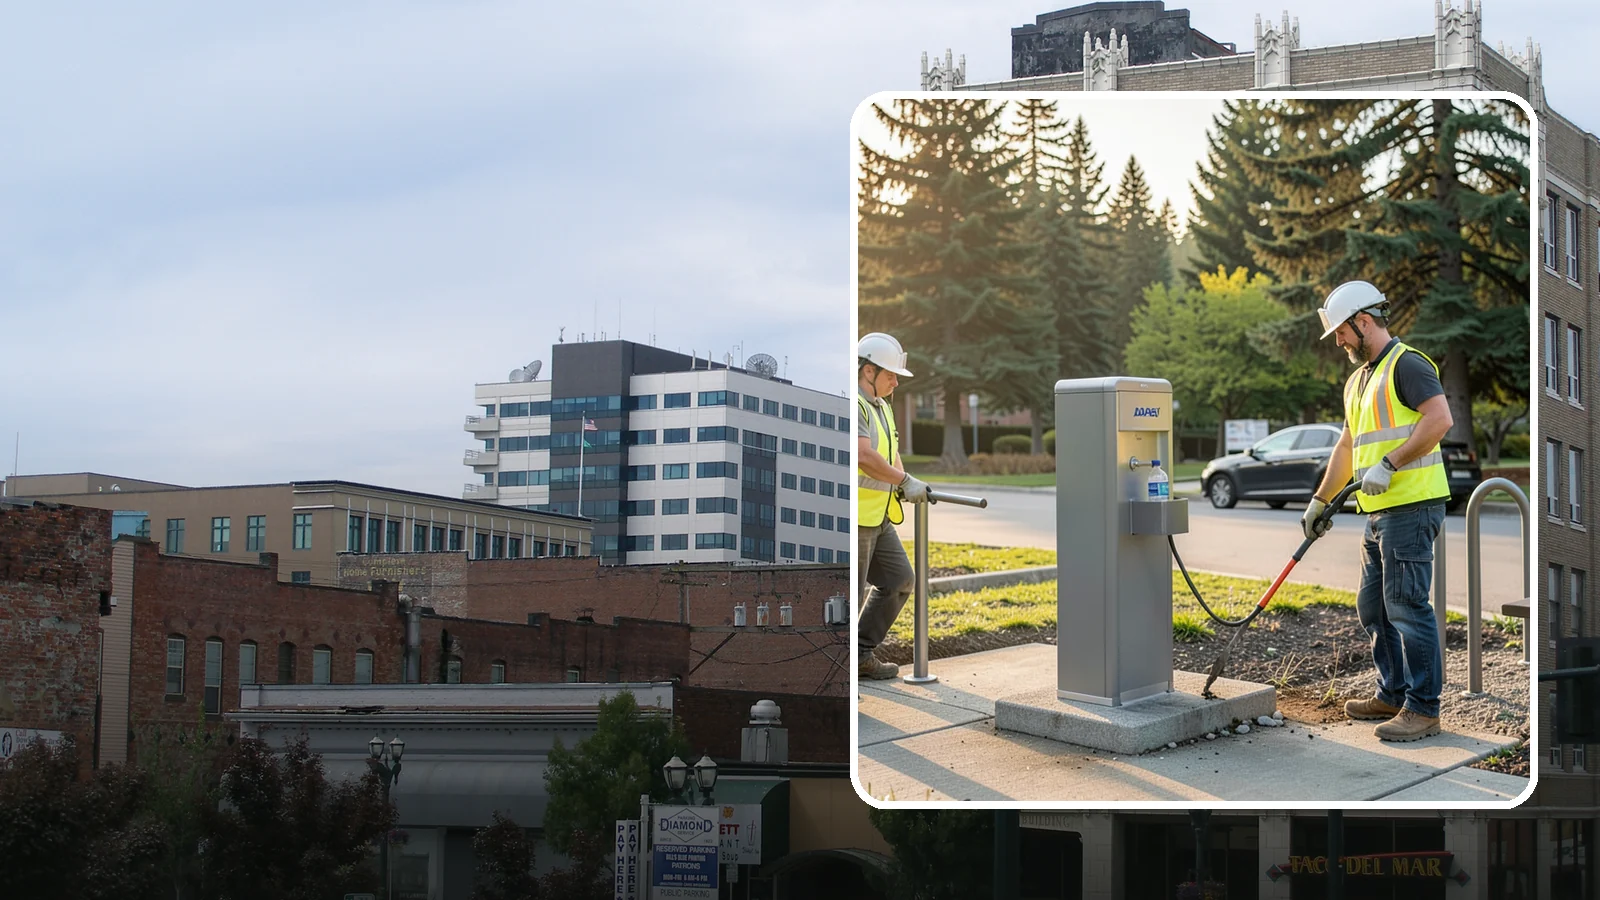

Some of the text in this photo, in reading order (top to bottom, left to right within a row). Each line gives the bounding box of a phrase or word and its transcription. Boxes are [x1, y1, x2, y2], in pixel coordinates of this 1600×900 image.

[343, 566, 427, 577] Home Furnishers
[660, 818, 713, 833] DIAMOND
[1022, 815, 1070, 828] BUILDING
[616, 825, 625, 893] PAY HERE
[627, 824, 637, 893] PAY HERE
[721, 851, 739, 861] Soup
[671, 862, 701, 870] PATRONS
[1346, 856, 1384, 876] DEL
[1392, 857, 1443, 877] MAR
[660, 888, 710, 898] PUBLIC PARKING
